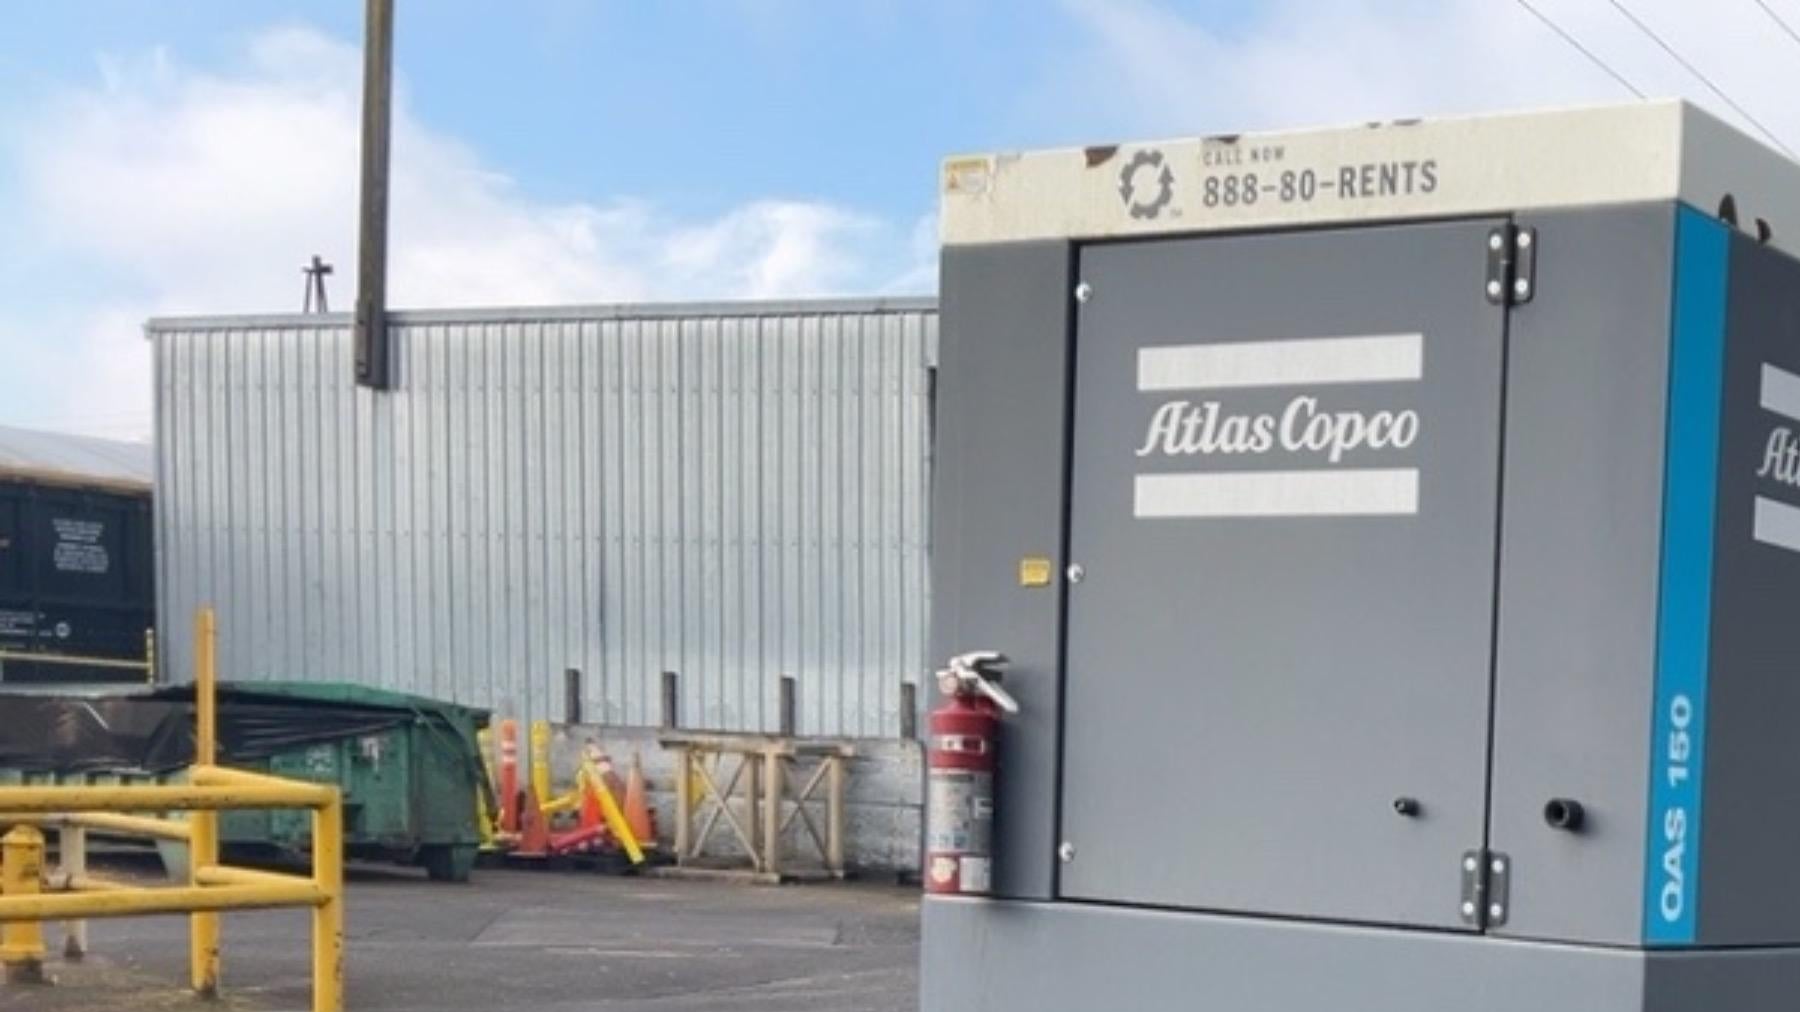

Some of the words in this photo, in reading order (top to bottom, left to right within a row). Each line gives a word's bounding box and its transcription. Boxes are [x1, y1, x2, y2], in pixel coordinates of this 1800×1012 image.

[1203, 149, 1242, 167] CALL
[1250, 146, 1285, 163] NOW
[1203, 159, 1439, 208] 888-80-RENTS
[1134, 399, 1276, 457] Atlas
[1278, 395, 1420, 463] Copco
[1667, 693, 1693, 789] 150
